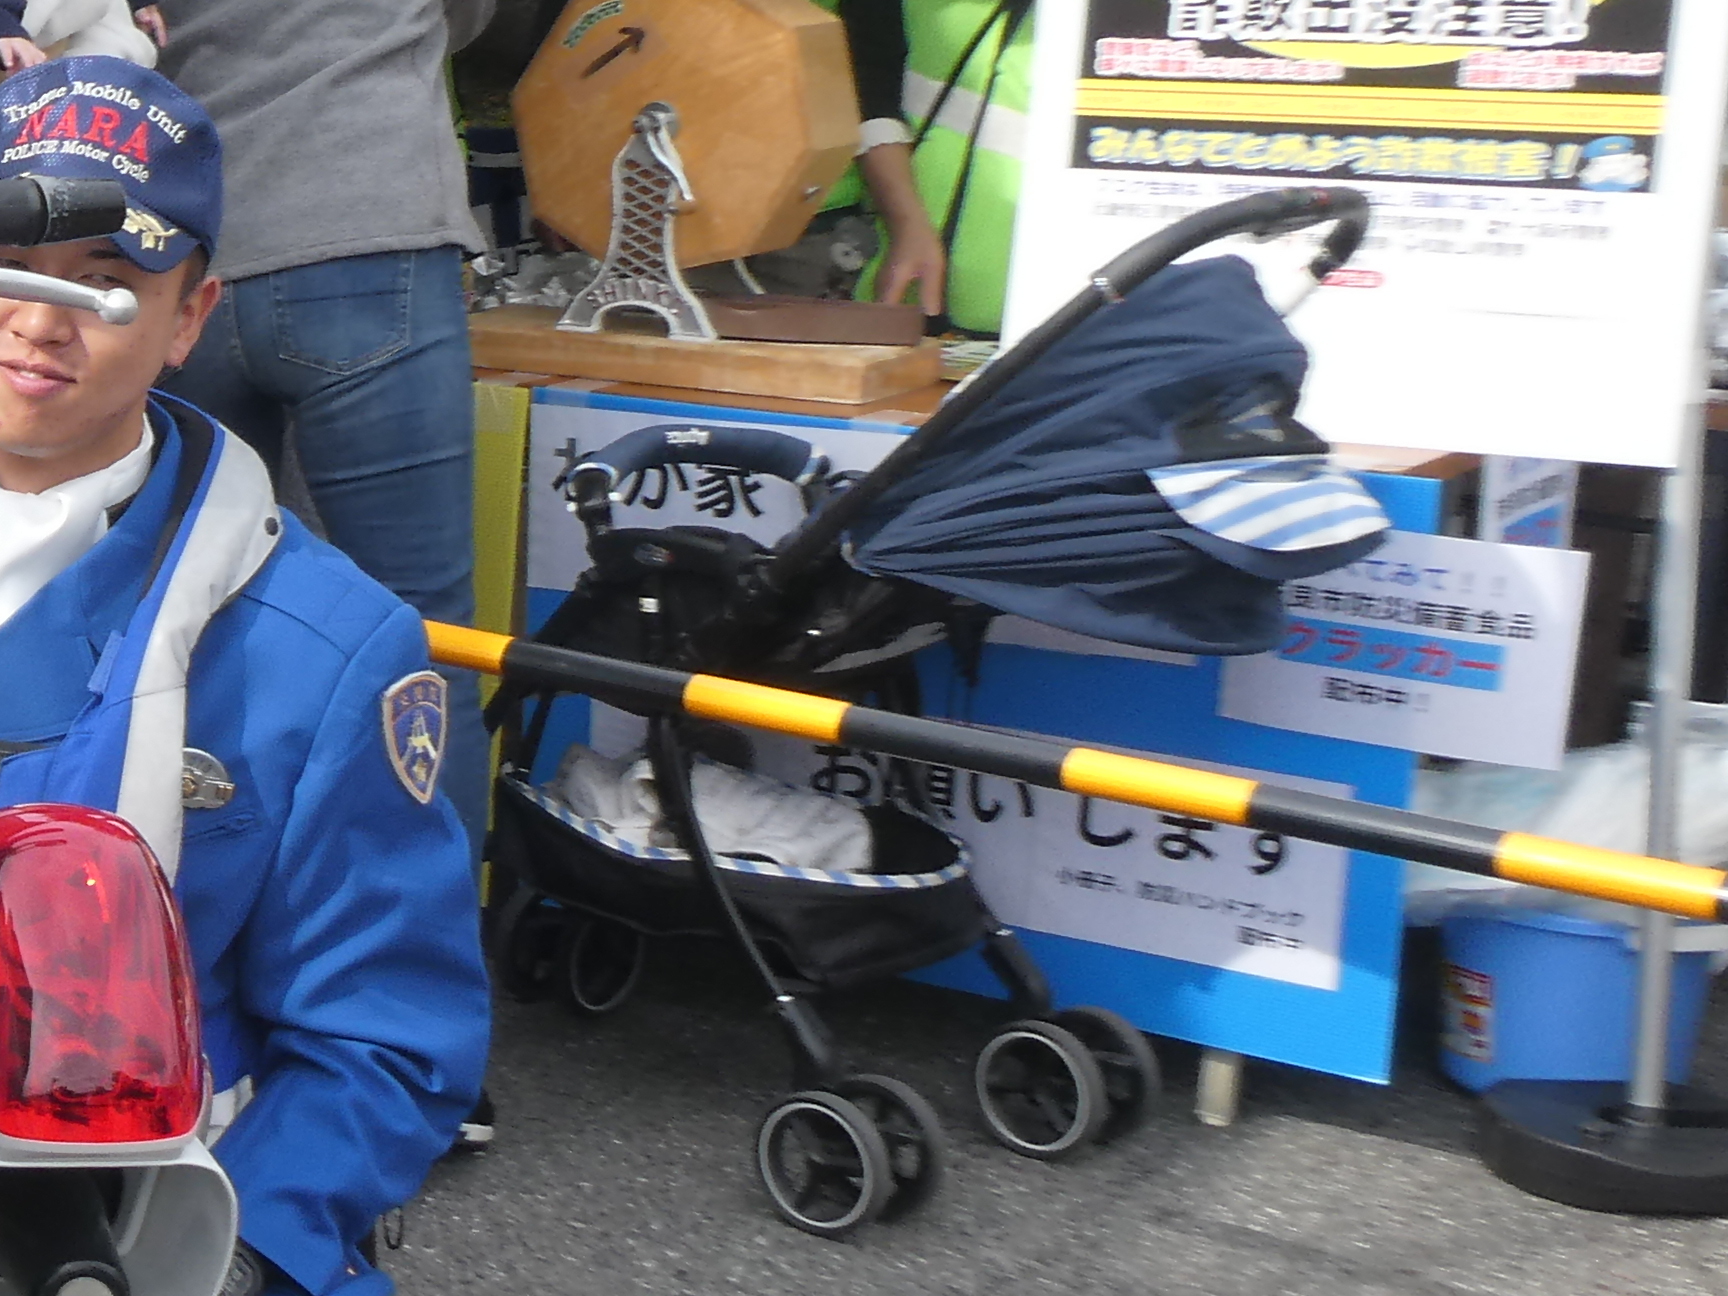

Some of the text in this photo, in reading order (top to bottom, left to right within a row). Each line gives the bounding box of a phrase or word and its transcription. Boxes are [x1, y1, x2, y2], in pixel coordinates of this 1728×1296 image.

[14, 103, 152, 164] NARA
[70, 80, 142, 112] Mobile
[146, 104, 189, 145] Unit
[0, 139, 153, 184] POLICE Motor Cycle
[552, 437, 869, 518] が家
[1281, 621, 1502, 678] クラッカー
